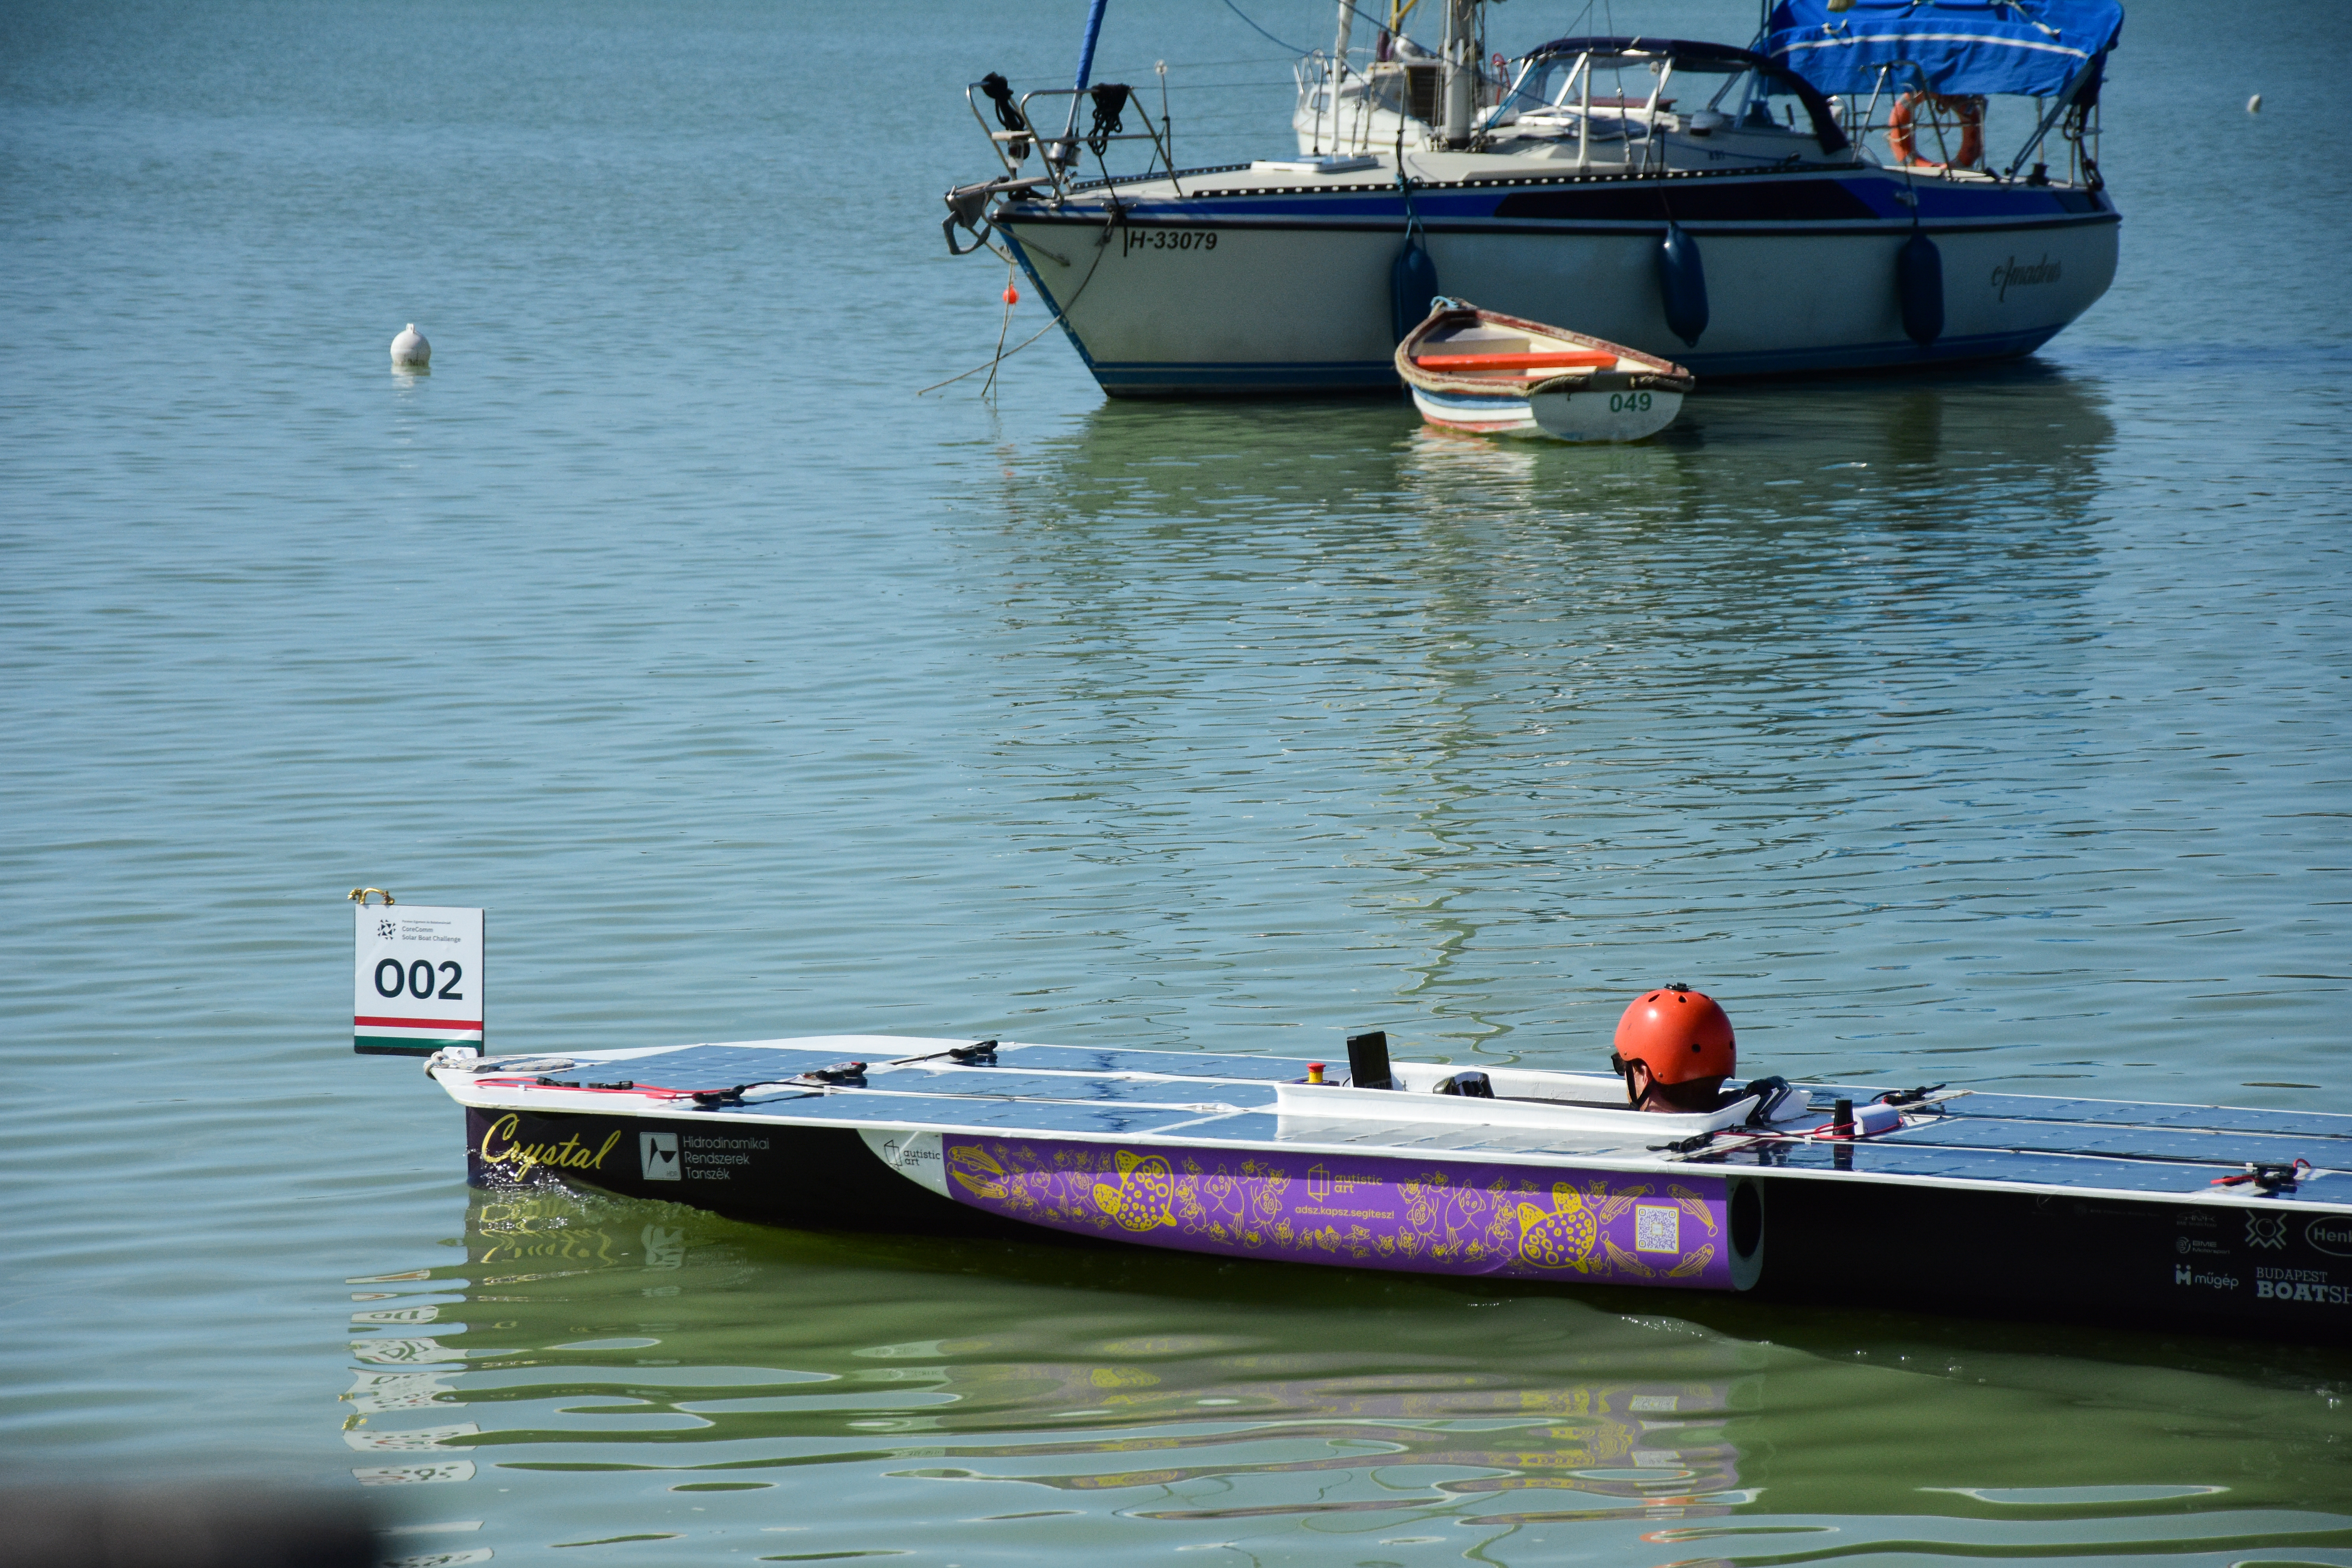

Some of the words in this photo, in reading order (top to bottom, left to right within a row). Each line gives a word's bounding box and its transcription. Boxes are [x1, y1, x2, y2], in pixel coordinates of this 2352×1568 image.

[1129, 230, 1218, 250] H-33079
[1610, 392, 1652, 412] 049
[481, 1113, 622, 1182] Crystal
[682, 1136, 769, 1150] Hidrodinamikai
[684, 1151, 750, 1165] Rendszerek
[903, 1149, 940, 1160] autistic
[904, 1158, 920, 1166] art
[685, 1167, 731, 1180] Tanszék
[1334, 1174, 1383, 1186] autistic
[1334, 1183, 1354, 1194] art
[2195, 1272, 2239, 1290] műgép
[2256, 1267, 2328, 1283] BUDAPEST
